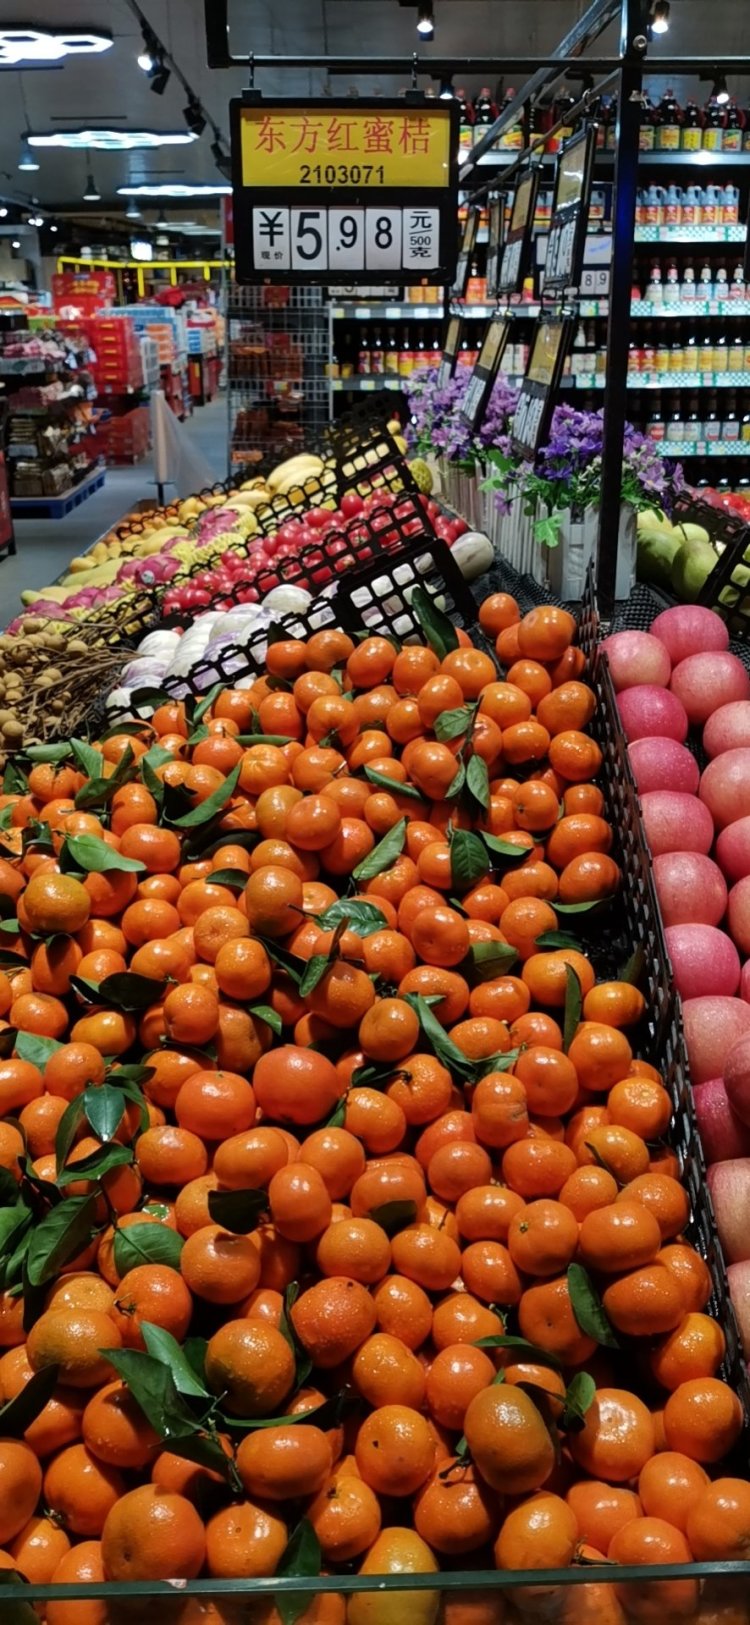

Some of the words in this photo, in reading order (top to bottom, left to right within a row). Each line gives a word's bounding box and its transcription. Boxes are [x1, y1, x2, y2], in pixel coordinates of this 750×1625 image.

[255, 116, 431, 155] 东方红蜜桔
[299, 165, 385, 184] 2103071
